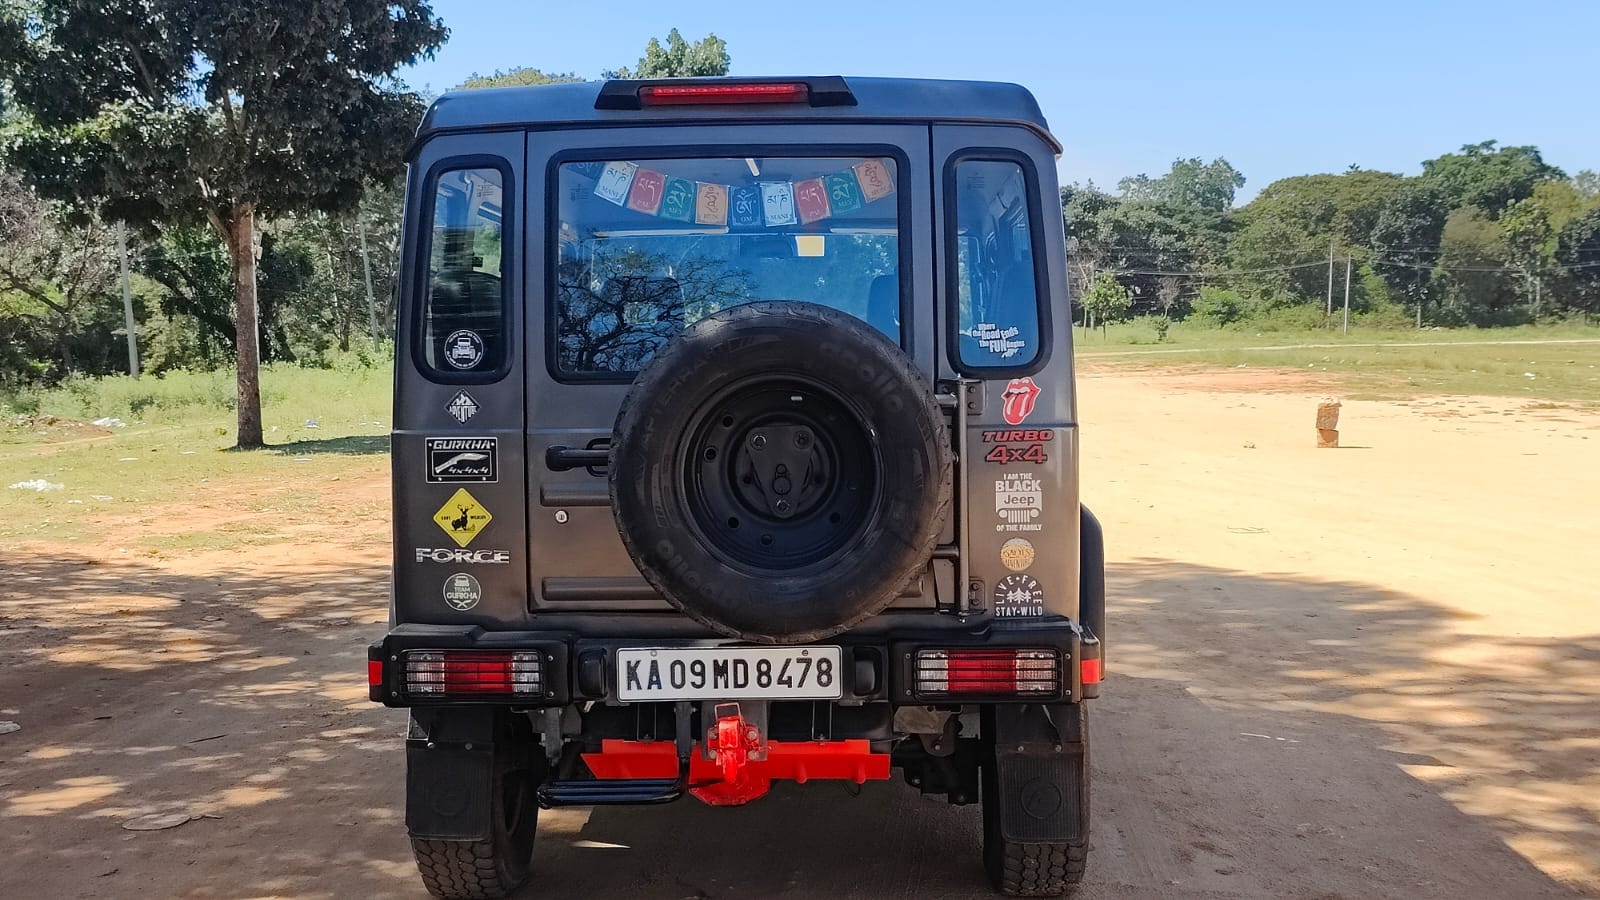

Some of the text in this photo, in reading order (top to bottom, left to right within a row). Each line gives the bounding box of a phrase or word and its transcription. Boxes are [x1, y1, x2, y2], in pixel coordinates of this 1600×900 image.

[981, 329, 1000, 340] Road
[1000, 326, 1019, 340] Ends
[990, 339, 1007, 353] FUN
[983, 429, 1054, 442] TURBO
[433, 440, 491, 450] GURKHA
[985, 444, 1048, 465] 4x4
[1019, 472, 1033, 480] THE
[995, 480, 1042, 491] BLACK
[1003, 494, 1035, 506] Jeep
[1019, 523, 1042, 531] FAMILY
[415, 548, 510, 564] FORCE
